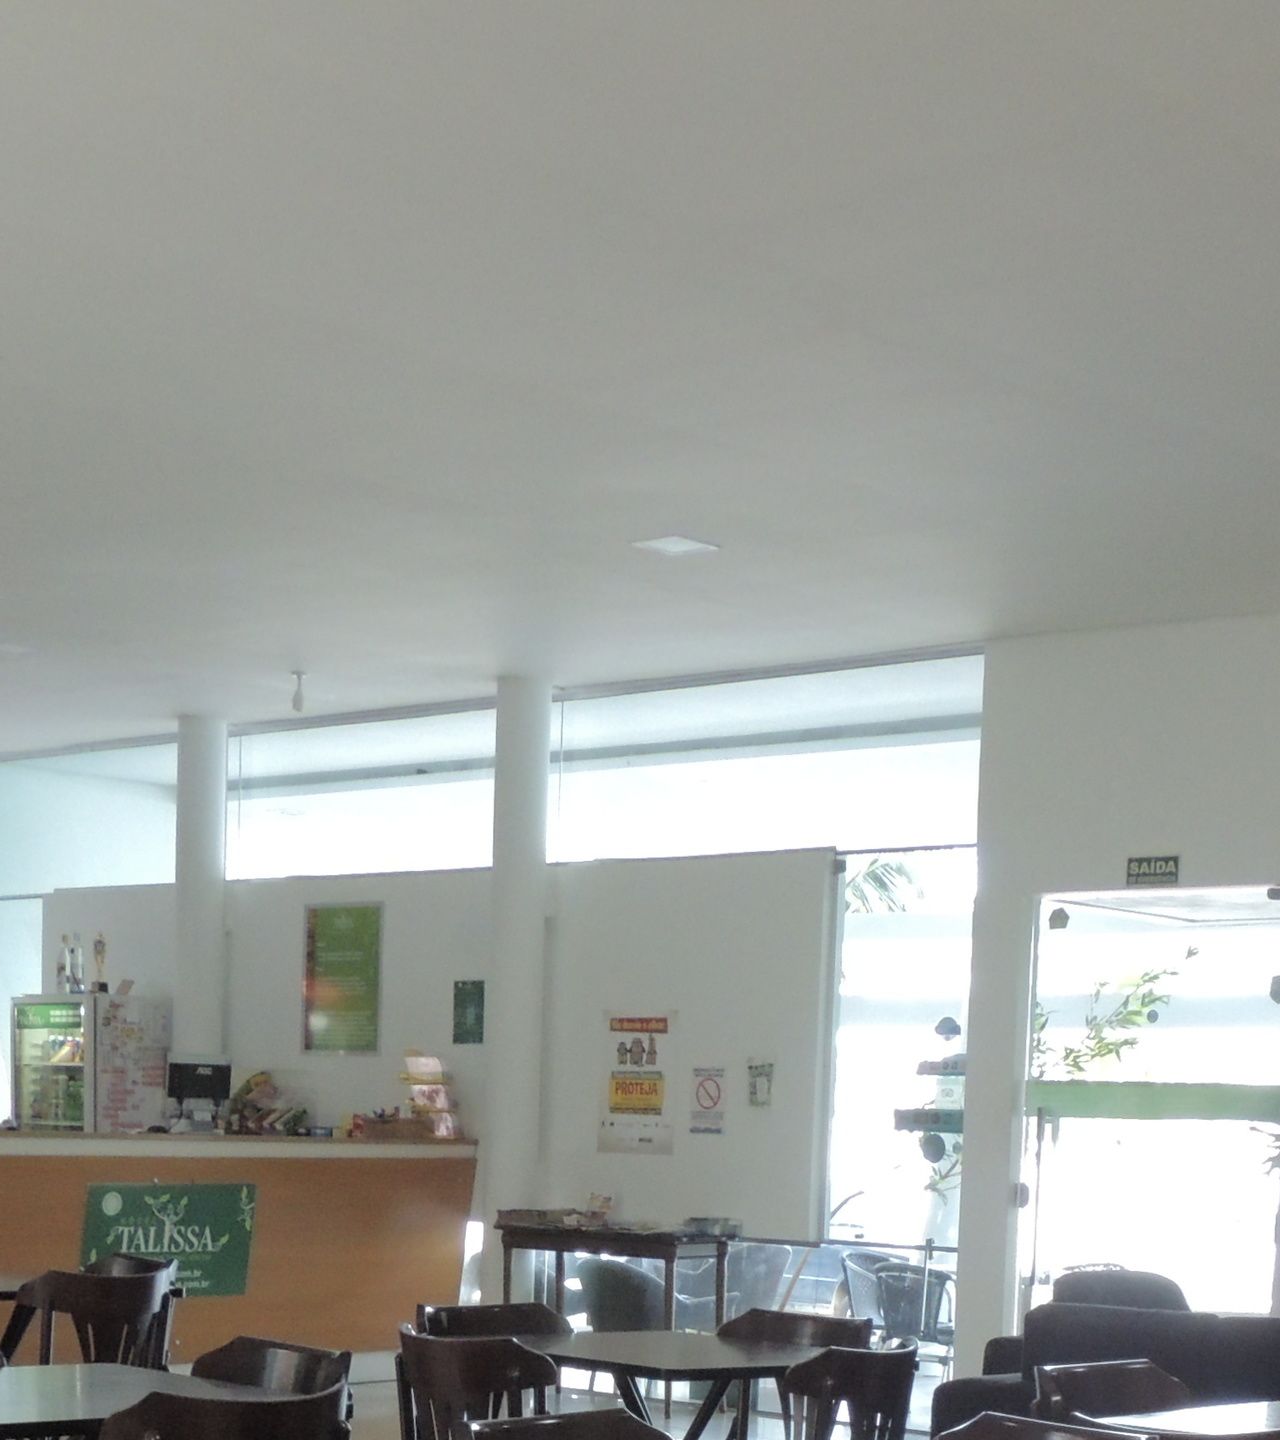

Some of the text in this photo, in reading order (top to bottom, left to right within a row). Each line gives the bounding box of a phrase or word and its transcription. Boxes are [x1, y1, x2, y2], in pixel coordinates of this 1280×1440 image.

[1129, 859, 1176, 874] SAÍDA
[615, 1081, 658, 1096] PROTEJA
[118, 1226, 217, 1252] TALISSA
